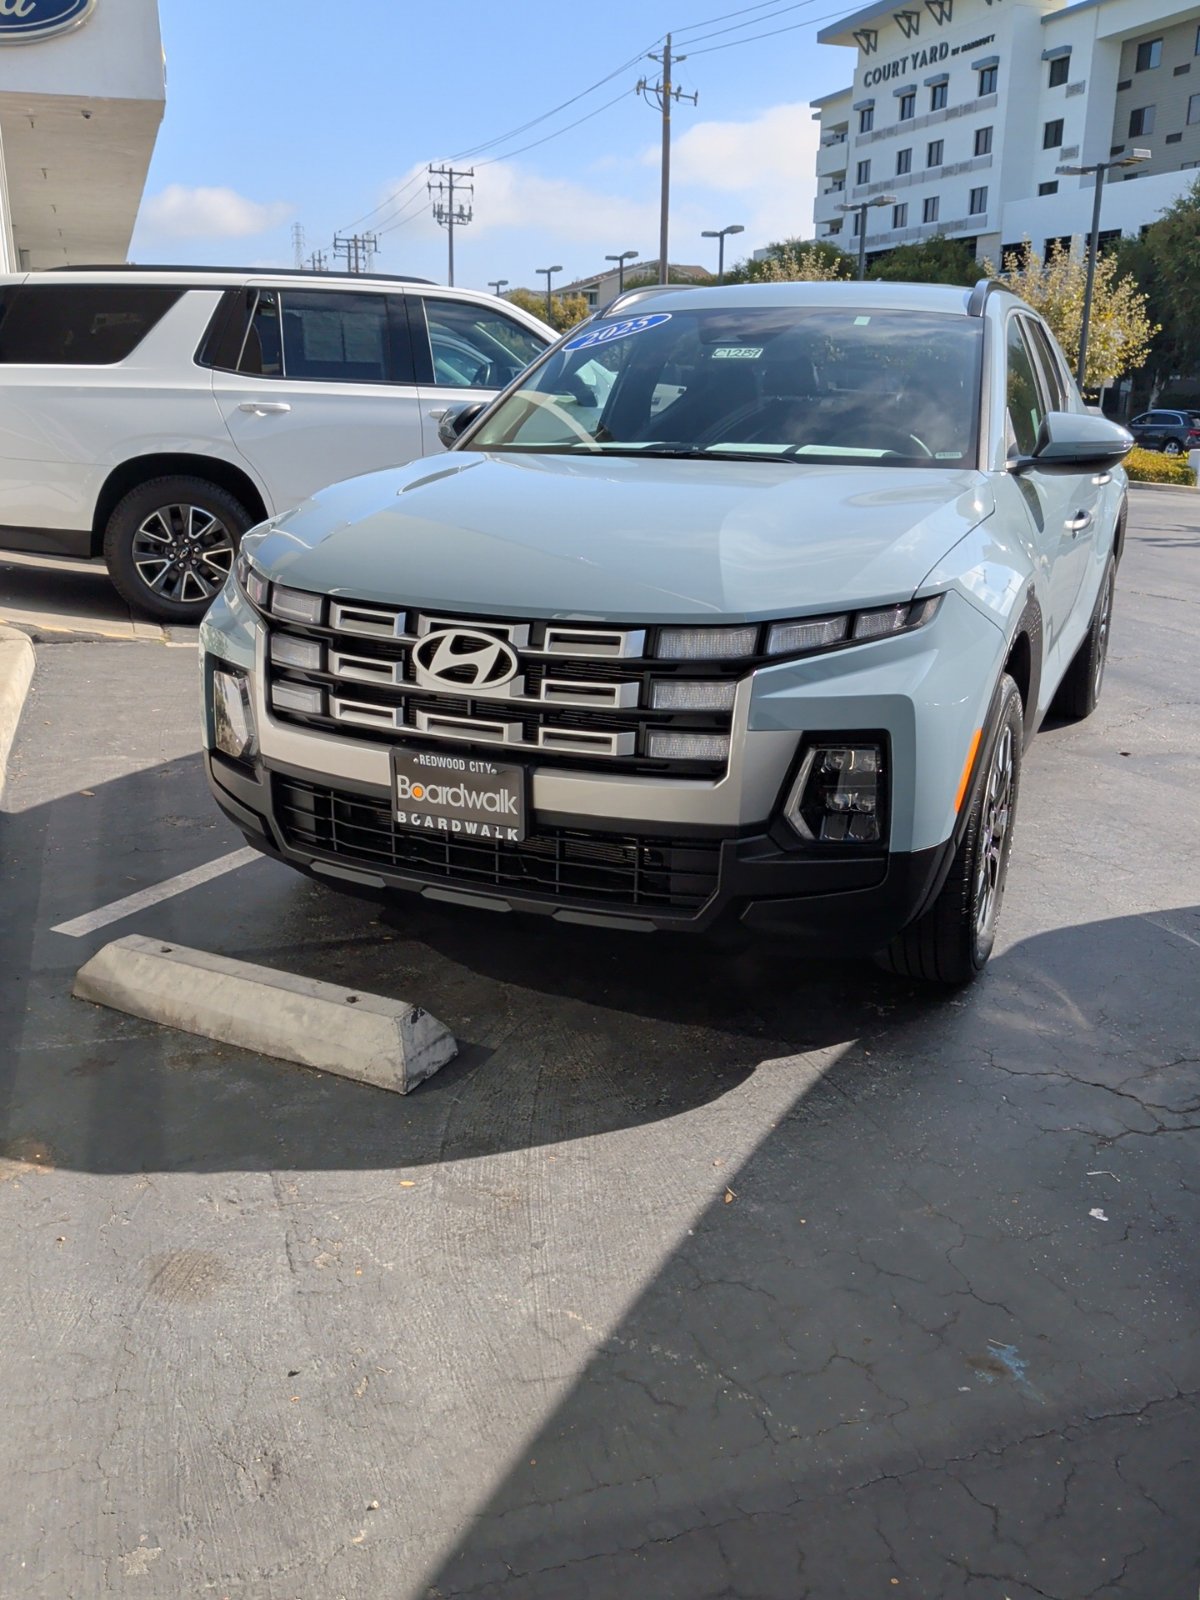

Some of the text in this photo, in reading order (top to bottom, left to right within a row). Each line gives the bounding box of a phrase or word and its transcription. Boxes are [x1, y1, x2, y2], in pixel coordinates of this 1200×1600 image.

[581, 316, 653, 348] 2025
[419, 754, 491, 773] REDWOOD CITY
[397, 775, 518, 815] Boardwalk
[397, 811, 518, 841] BOARDWALK
